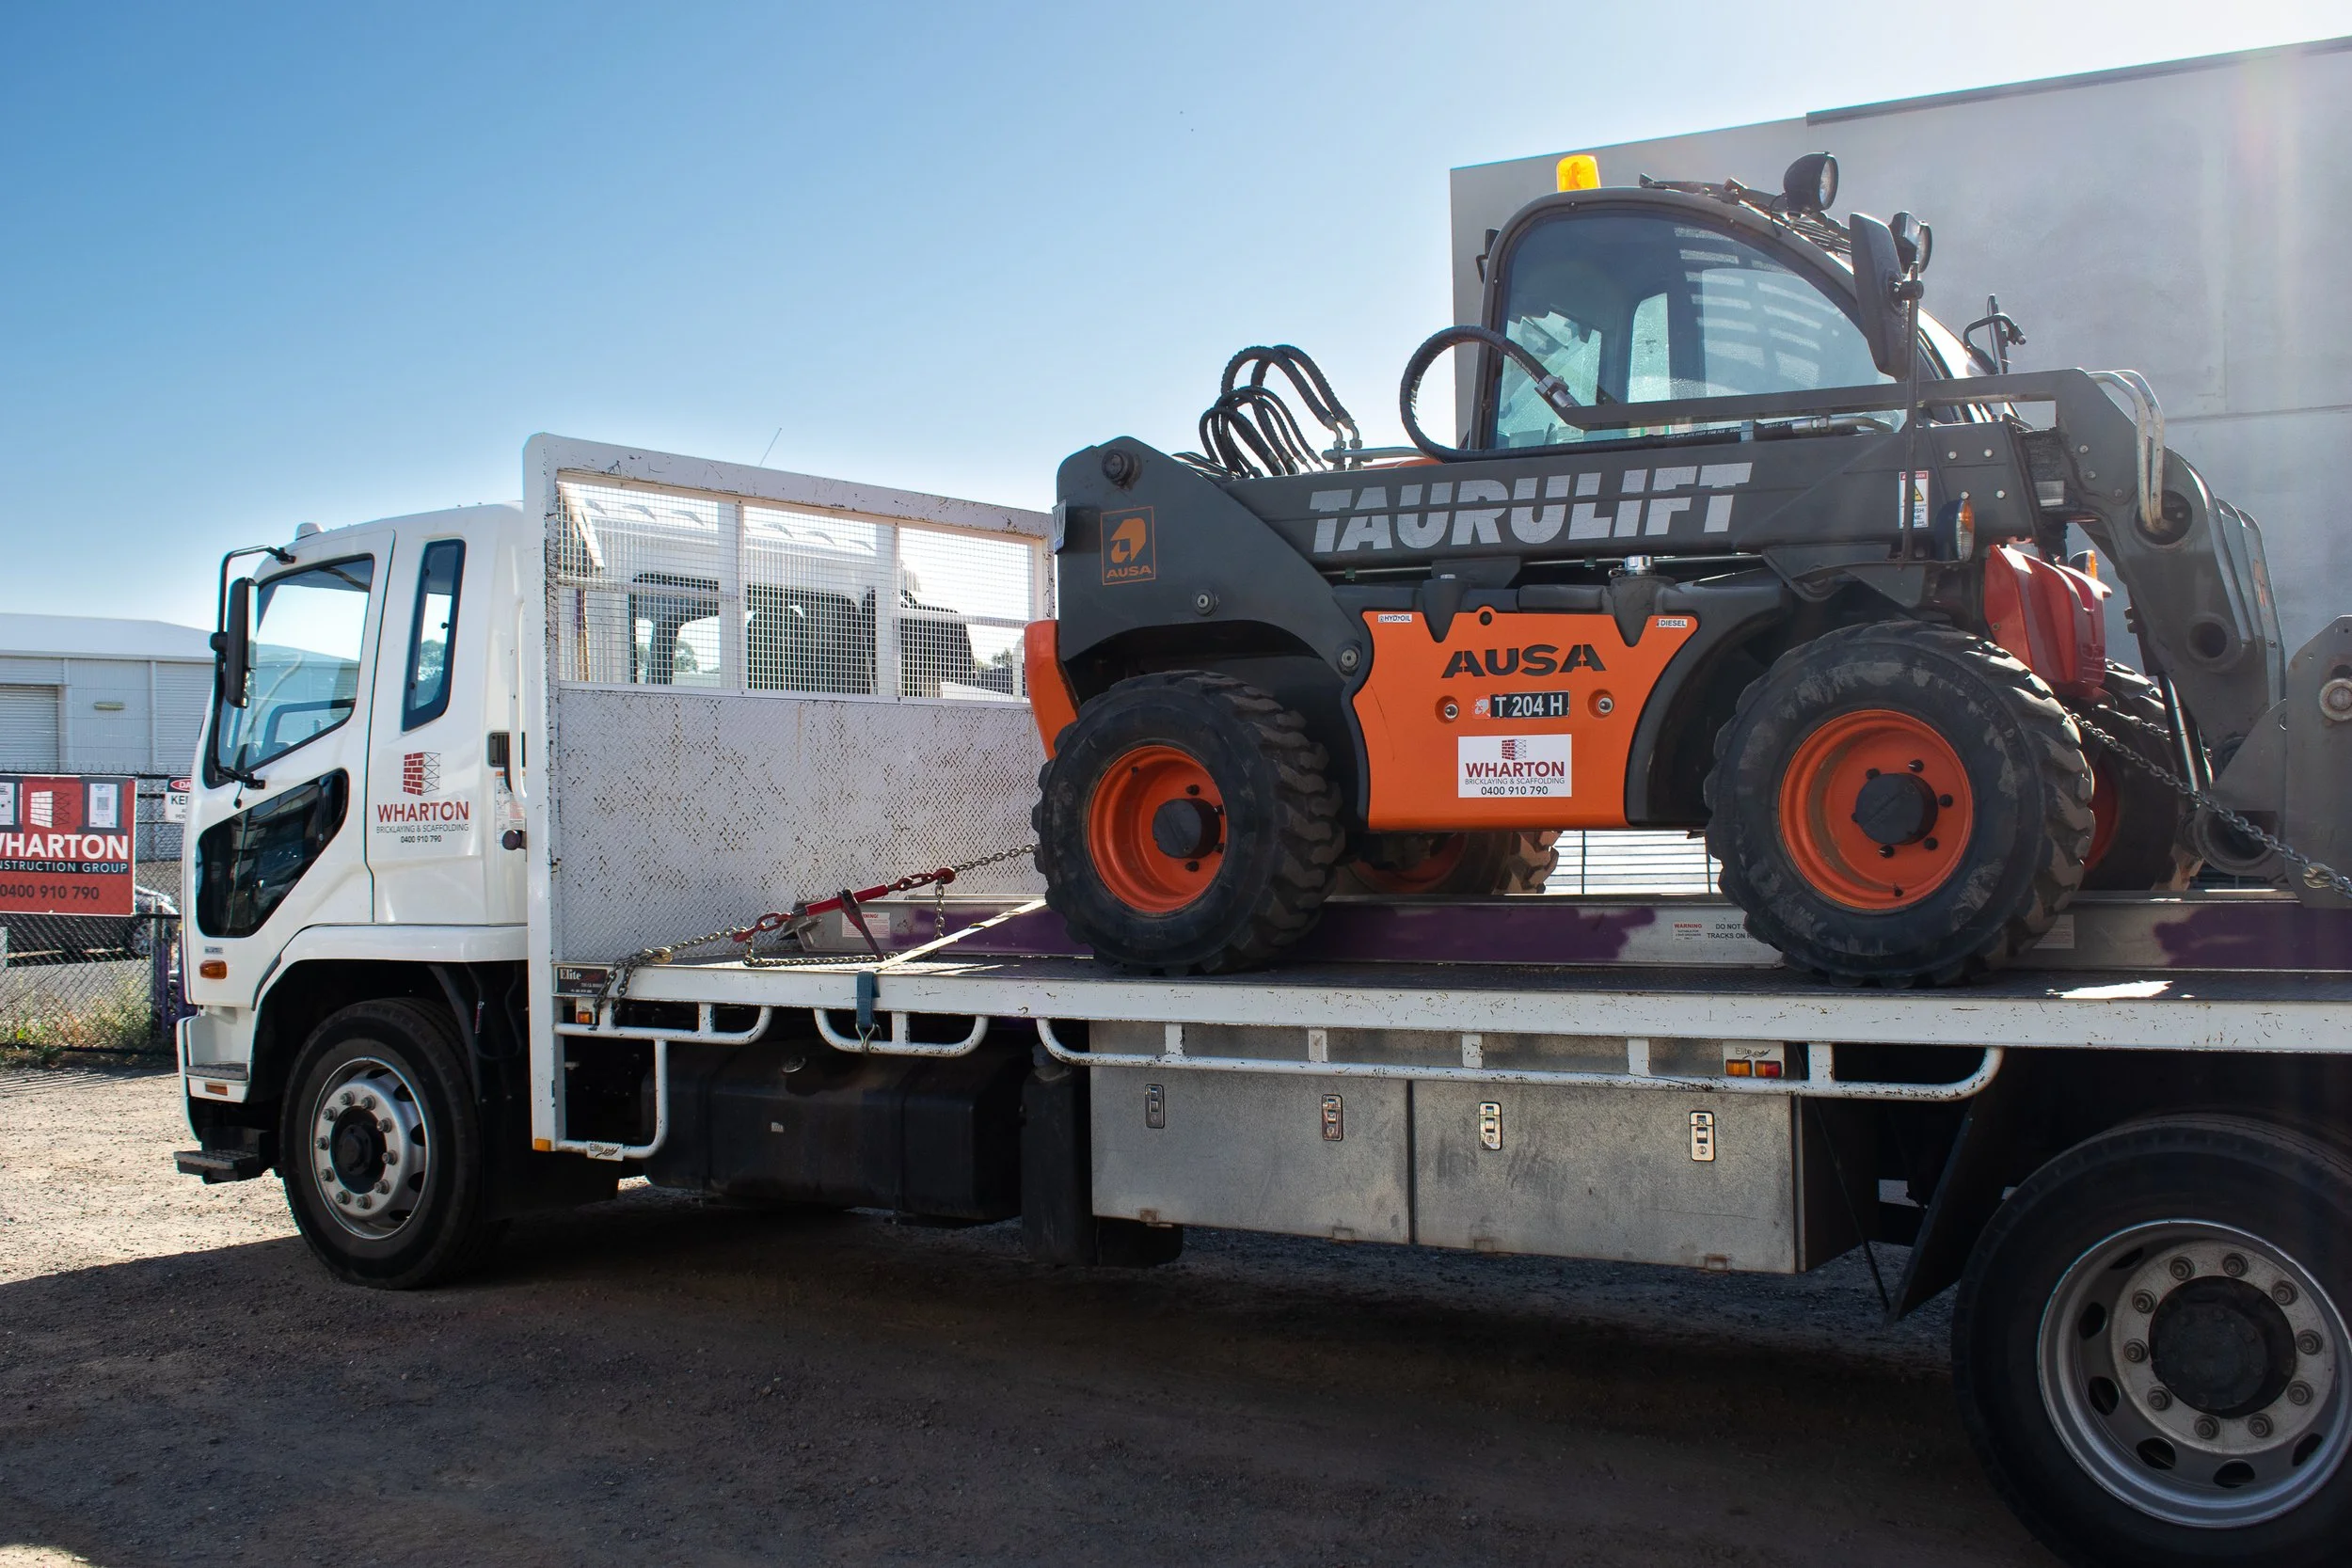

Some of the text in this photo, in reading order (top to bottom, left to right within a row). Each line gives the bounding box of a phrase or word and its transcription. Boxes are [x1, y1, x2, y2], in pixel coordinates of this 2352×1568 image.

[1309, 462, 1754, 553] TAURULIFT
[1106, 564, 1152, 578] AUSA
[1441, 643, 1607, 679] AUSA
[1494, 694, 1563, 718] T 204 H
[1465, 761, 1565, 778] WHARTON
[1481, 785, 1549, 796] 0400 910 790
[377, 800, 469, 823] WHARTON
[376, 825, 415, 834] BRICKLAYING
[422, 823, 469, 832] SCAFFOLDING
[0, 832, 129, 860] HARTON
[400, 835, 416, 844] 0400
[429, 834, 442, 843] 790
[82, 863, 128, 873] GROUP
[0, 884, 100, 900] 0400 910 790
[559, 968, 581, 980] Elite
